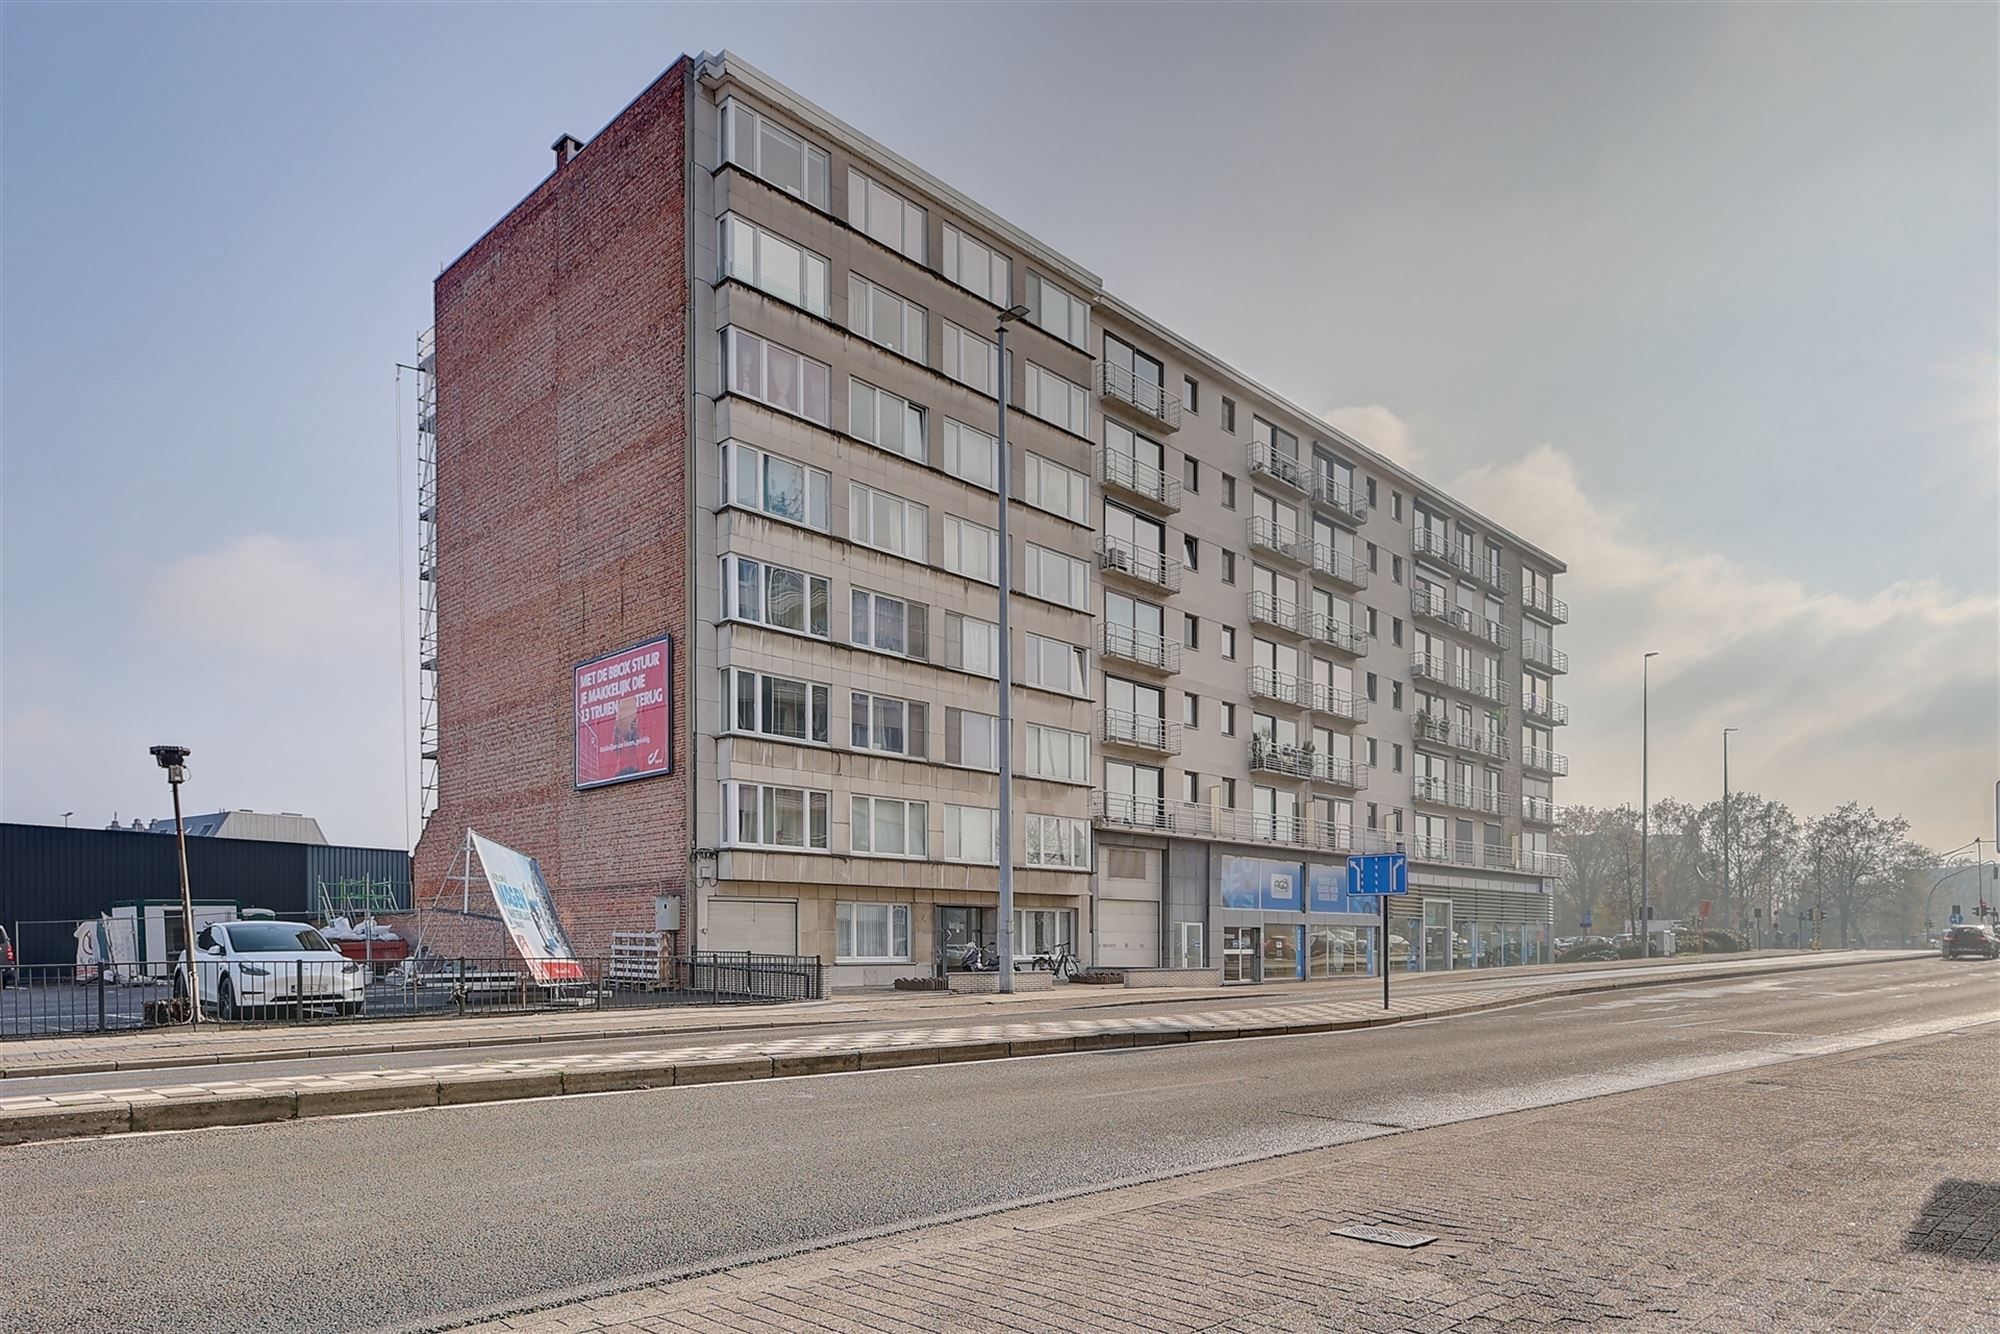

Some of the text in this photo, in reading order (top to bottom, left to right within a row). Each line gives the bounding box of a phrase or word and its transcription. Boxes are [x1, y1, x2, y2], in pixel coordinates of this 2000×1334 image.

[580, 652, 660, 688] MET DE BBOX STUUR
[580, 674, 646, 708] JE MAKKELIJK DIE
[591, 700, 618, 720] TRUIEN
[635, 688, 663, 707] TERUG
